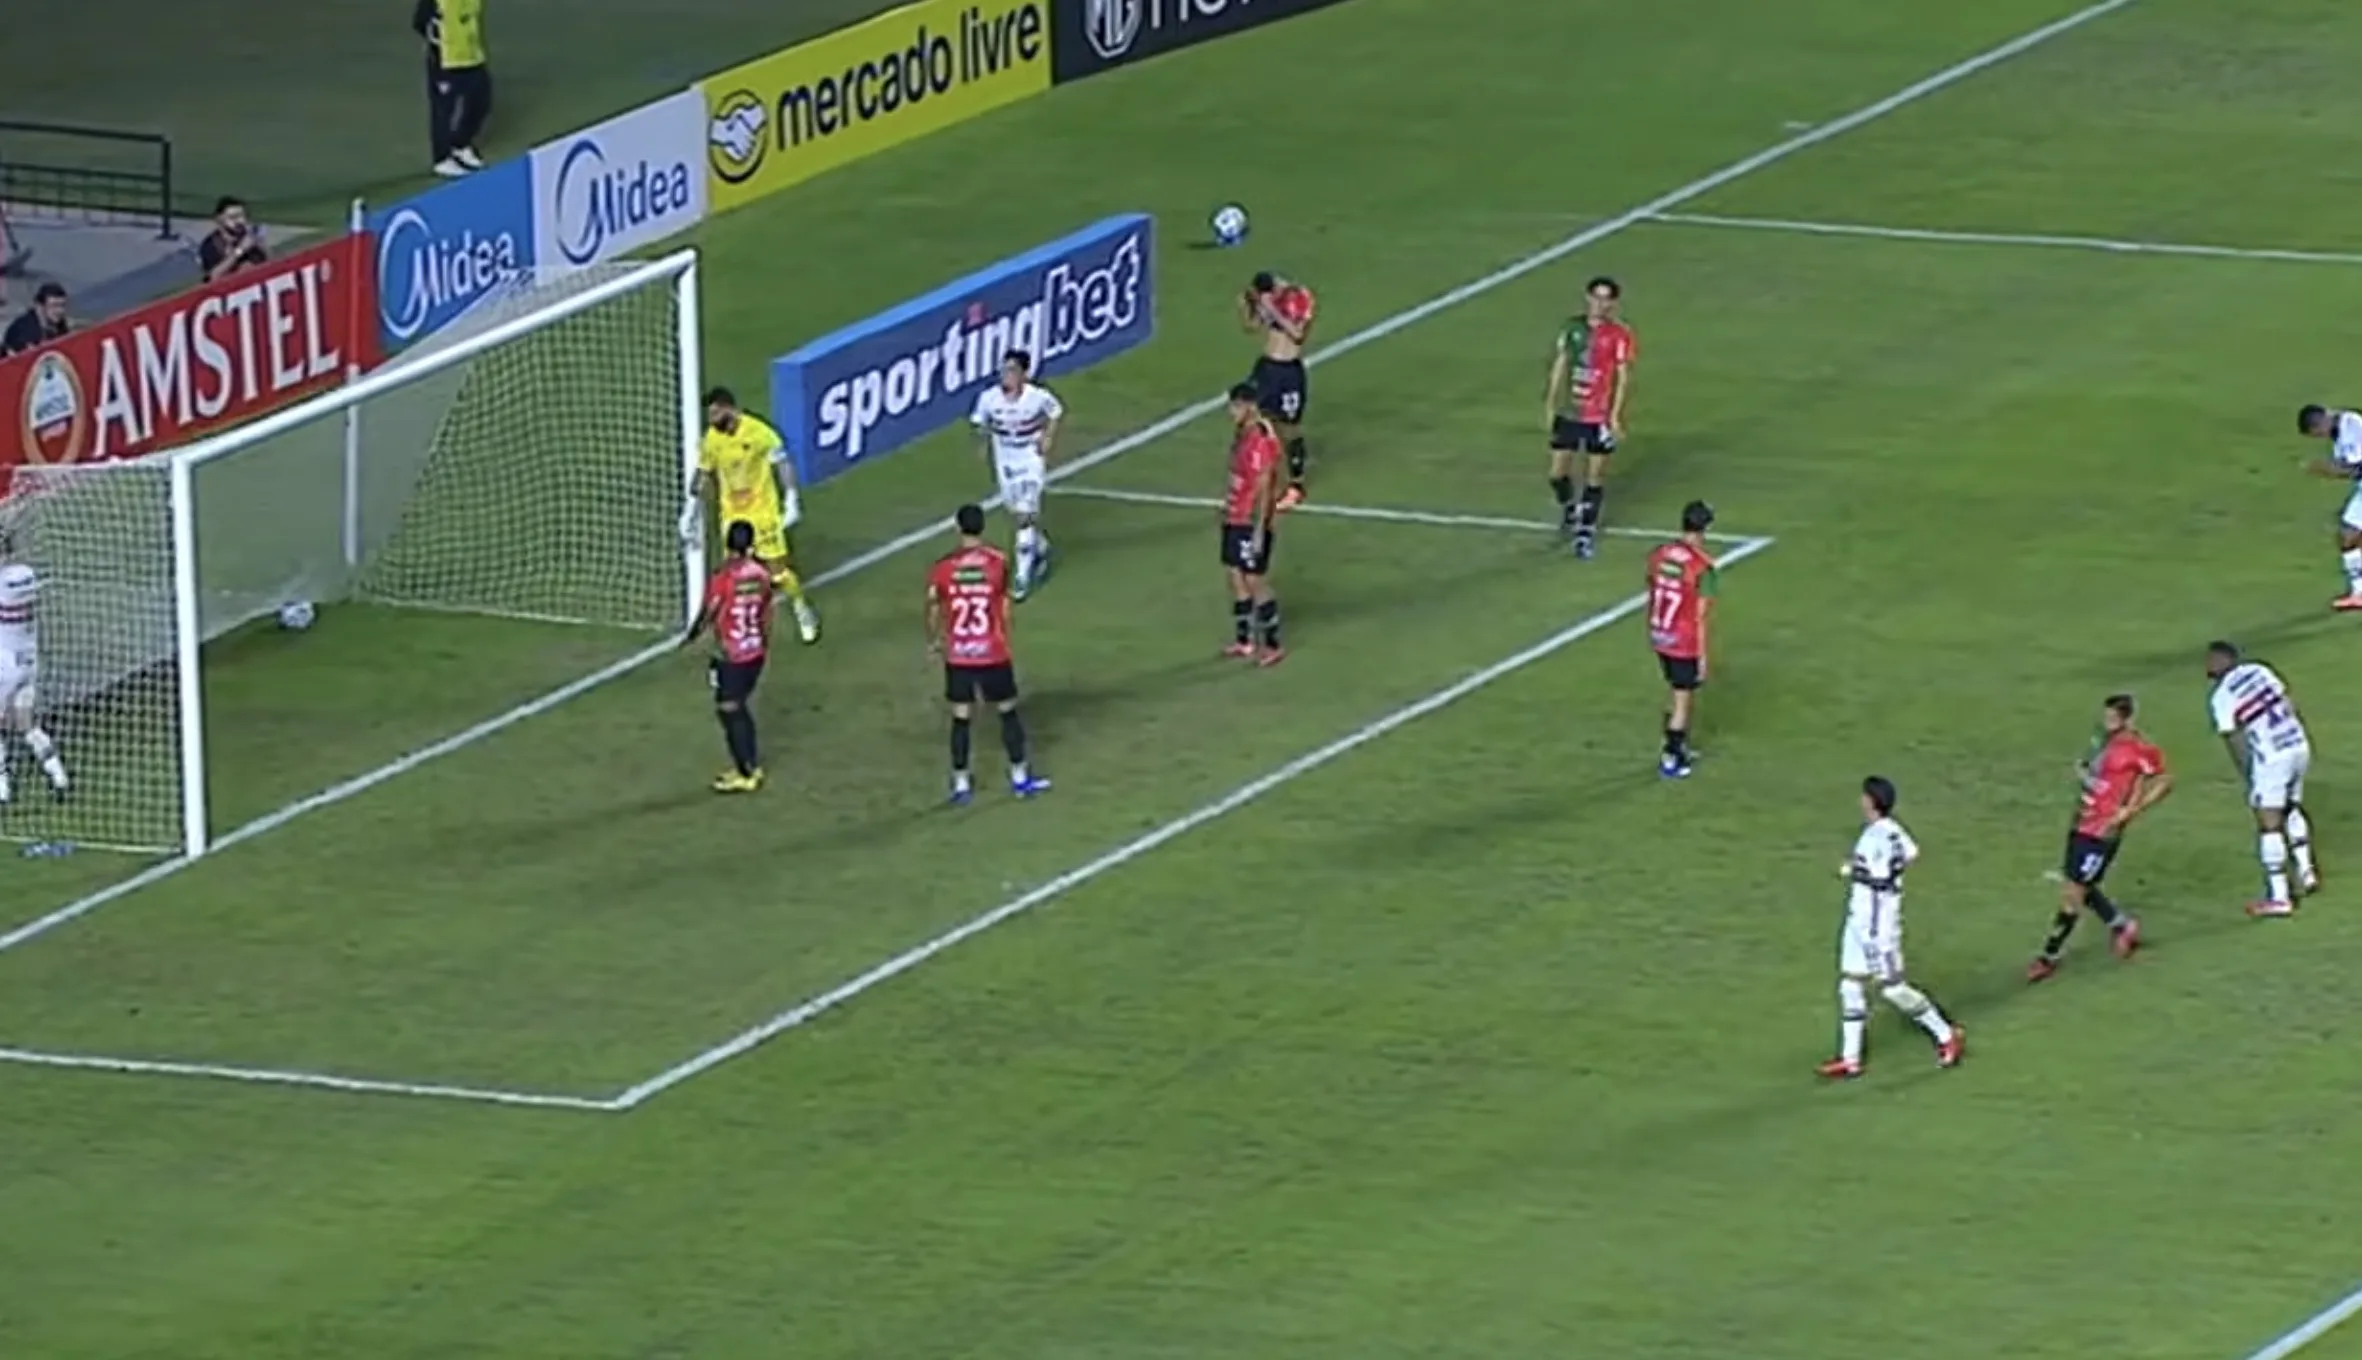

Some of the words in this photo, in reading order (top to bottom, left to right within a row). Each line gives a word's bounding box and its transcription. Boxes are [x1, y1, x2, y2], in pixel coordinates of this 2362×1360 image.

[776, 24, 953, 151] mercado
[959, 3, 1041, 84] livre
[556, 140, 690, 265] Midea
[379, 209, 516, 338] Midea
[92, 263, 341, 458] AMSTEL
[817, 233, 1140, 458] sportingbet
[951, 596, 989, 636] 23
[1650, 587, 1683, 630] 17
